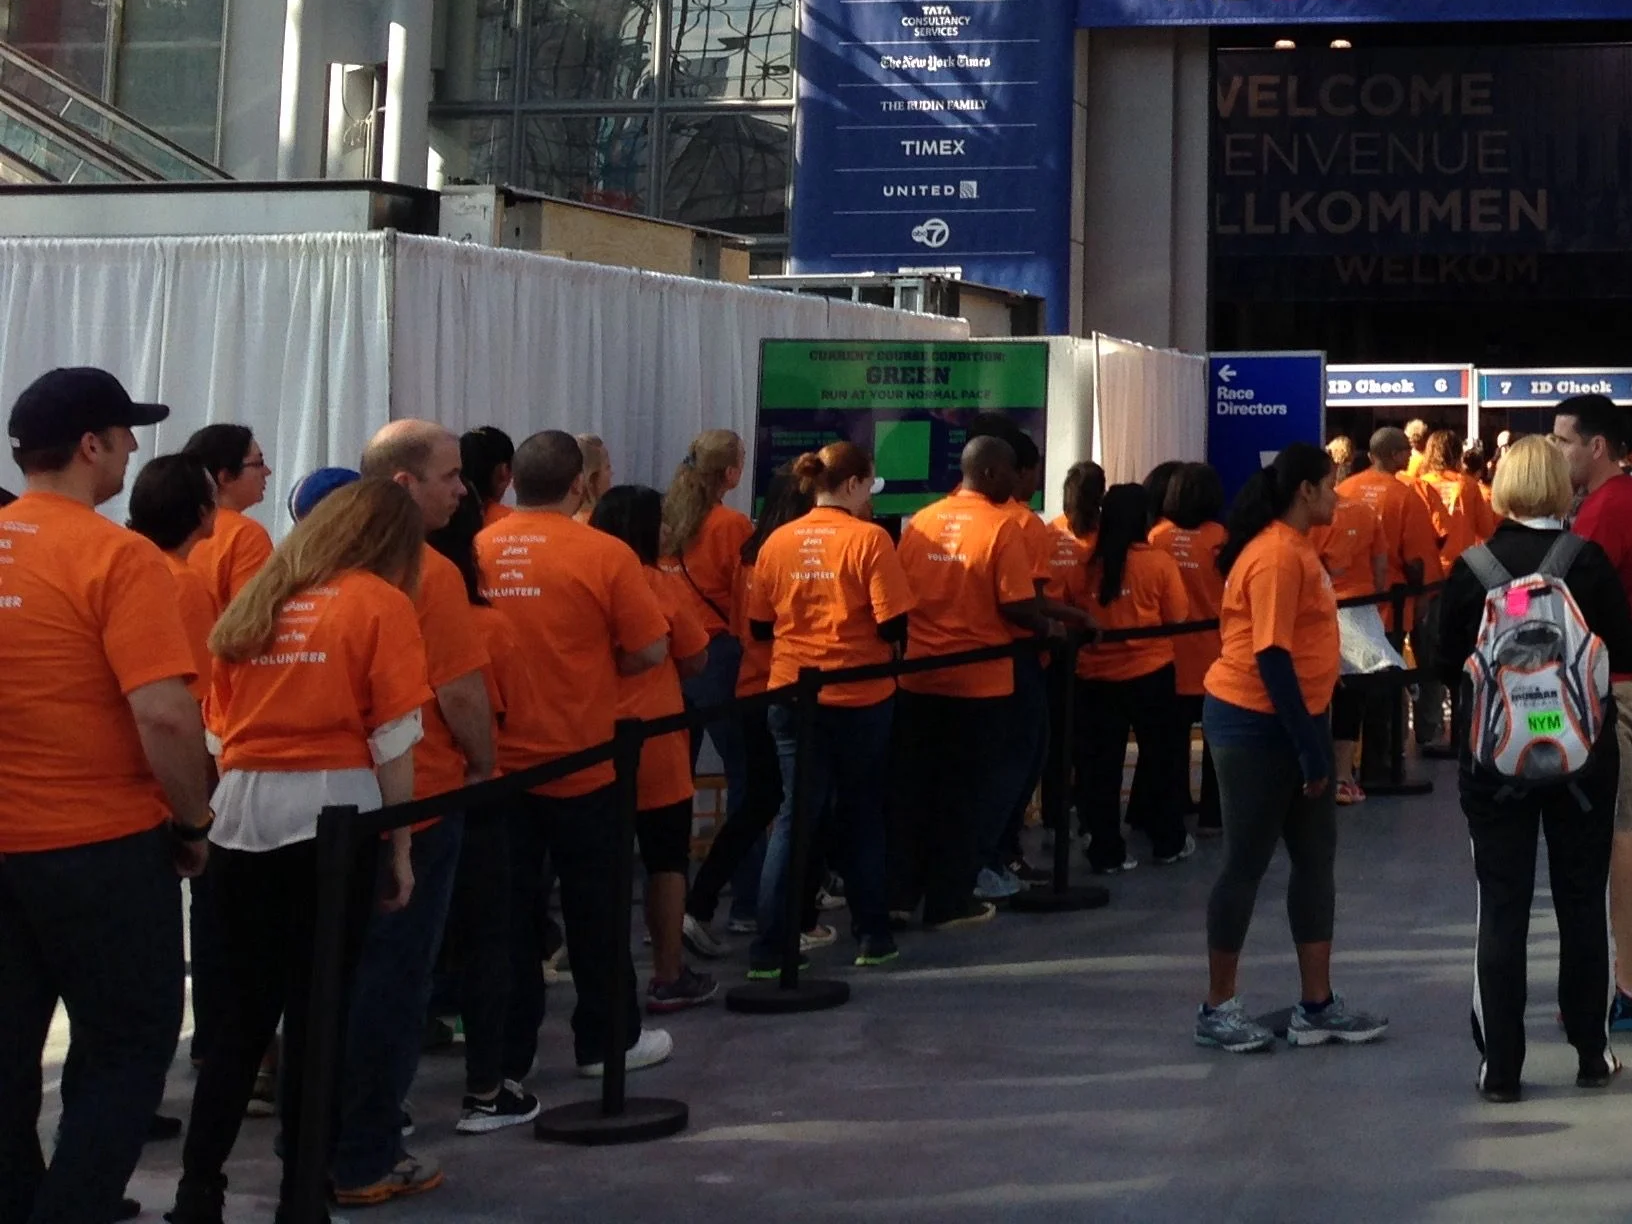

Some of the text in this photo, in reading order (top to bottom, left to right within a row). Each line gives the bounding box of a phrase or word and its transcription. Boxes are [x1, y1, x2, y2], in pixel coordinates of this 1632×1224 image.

[922, 7, 951, 15] TATA
[902, 16, 971, 27] CONSULTANCY
[914, 27, 959, 37] SERVICES
[880, 54, 991, 72] The New York Times
[880, 98, 988, 111] THE RUDIN FAMILY
[901, 140, 966, 156] TIMEX
[883, 185, 955, 197] UNITED
[866, 366, 951, 385] GREEN
[1217, 386, 1255, 400] Race
[1328, 380, 1352, 394] ID
[1355, 378, 1415, 394] Check
[1501, 382, 1512, 394] 7
[1531, 382, 1553, 394] ID
[1556, 380, 1612, 394] Check
[821, 390, 992, 400] RUN AT YOUR NORMAL PACE
[1217, 401, 1287, 415] Directors
[1528, 715, 1561, 731] NYM
